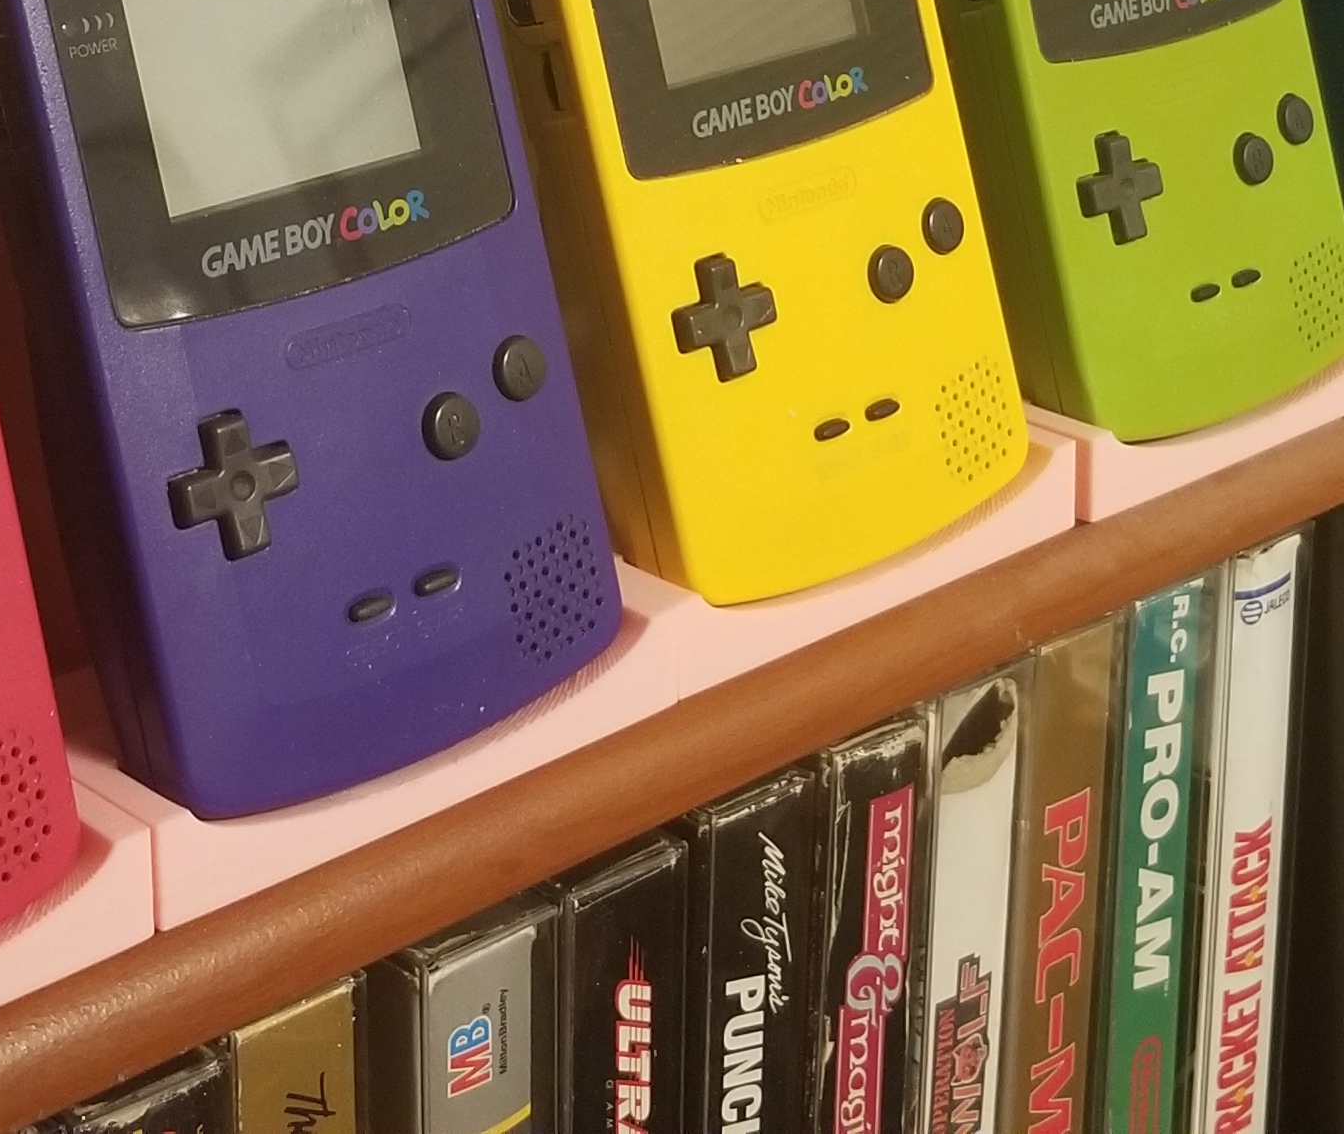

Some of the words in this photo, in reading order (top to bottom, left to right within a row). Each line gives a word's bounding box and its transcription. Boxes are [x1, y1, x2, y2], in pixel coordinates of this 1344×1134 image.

[68, 36, 119, 61] POWER
[692, 95, 755, 139] GAME
[755, 84, 796, 123] BOY
[797, 65, 870, 111] COLOR
[201, 227, 281, 279] GAME
[285, 212, 337, 257] BOY
[338, 189, 431, 243] COLOR
[1169, 594, 1191, 664] R.C.
[1263, 588, 1291, 615] JALECO
[1132, 667, 1186, 993] PRO-AM
[758, 830, 788, 914] Mike
[872, 802, 905, 953] might
[1225, 814, 1274, 977] ATTACK
[497, 988, 510, 1036] Bradley
[844, 952, 906, 1026] &
[447, 1014, 493, 1099] MB
